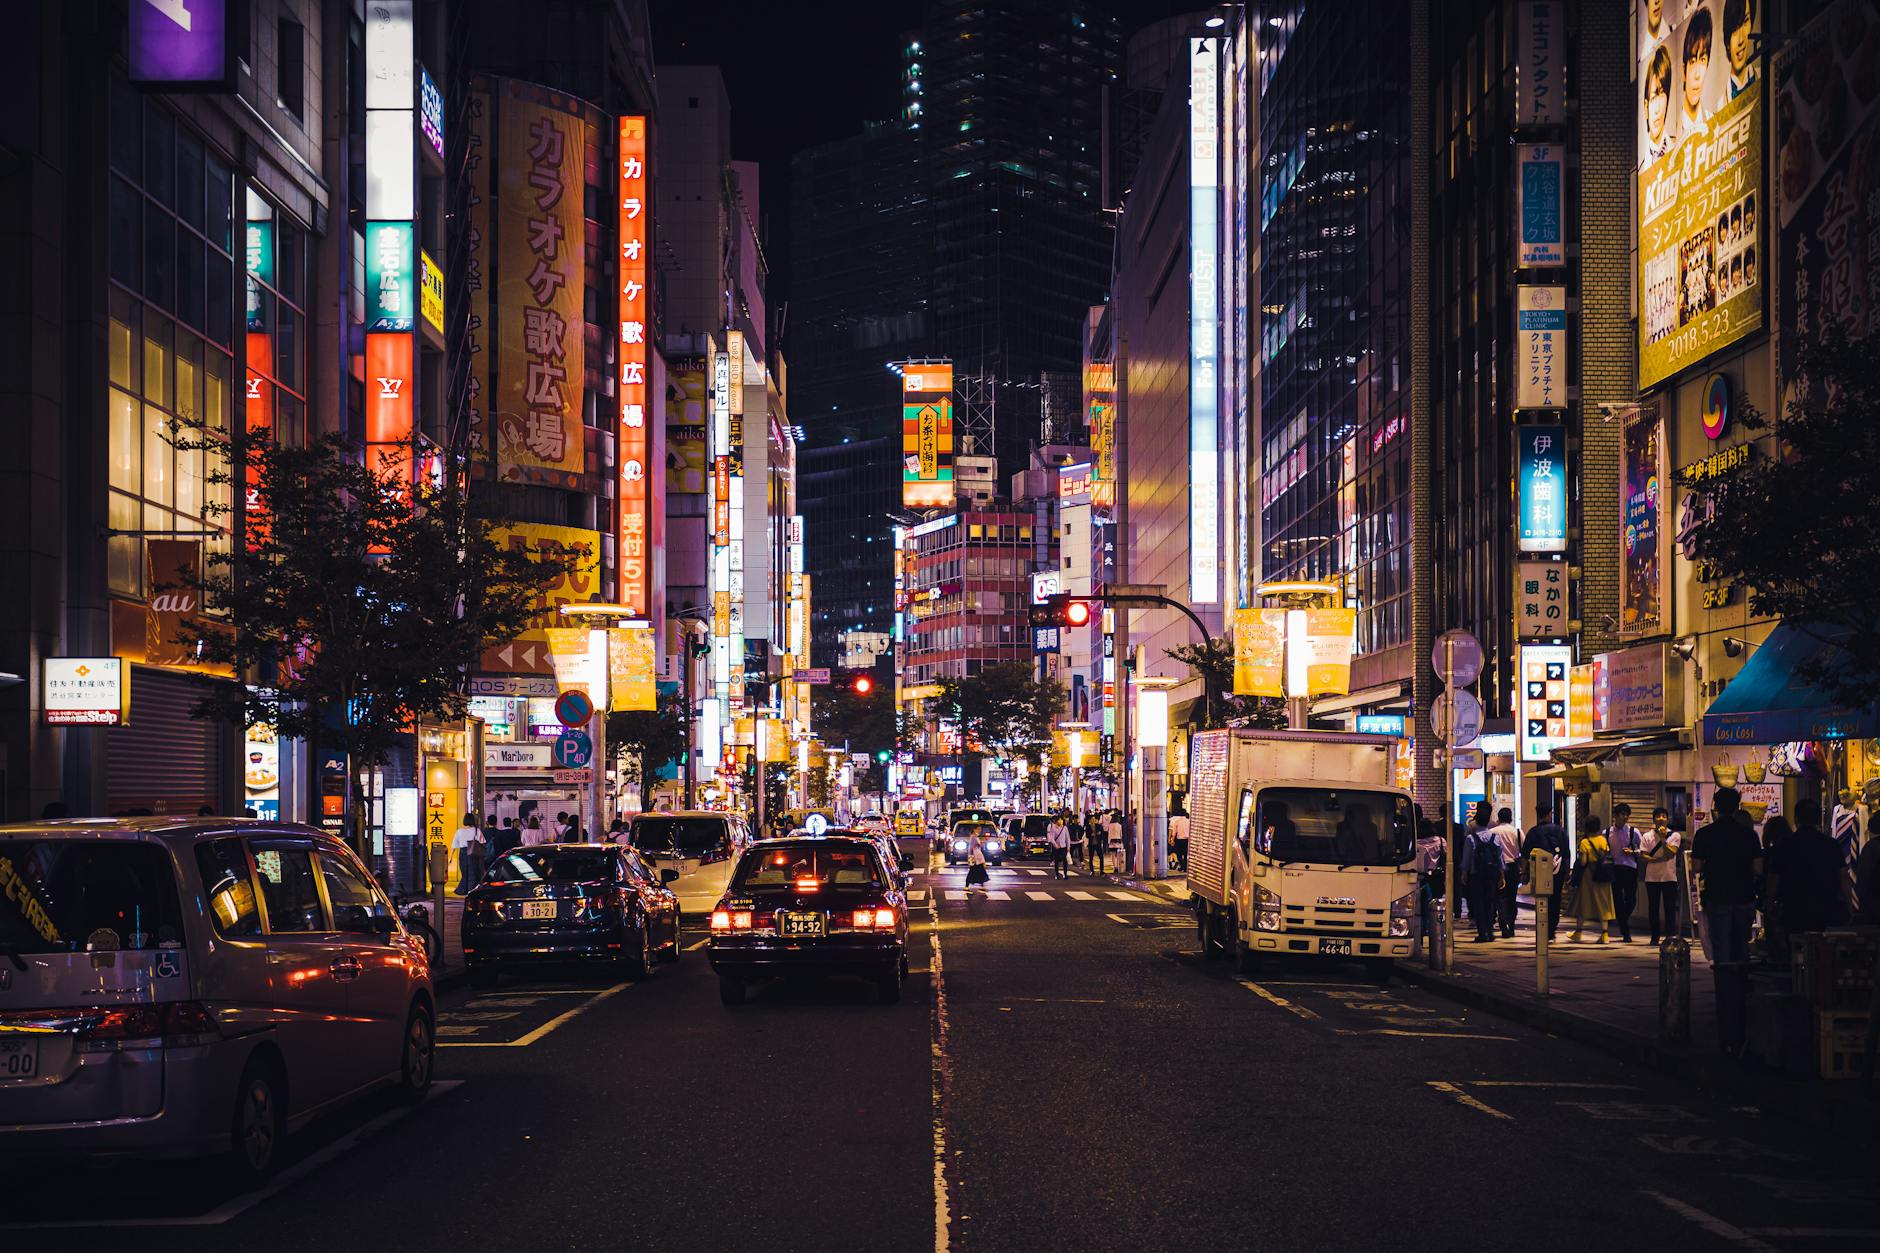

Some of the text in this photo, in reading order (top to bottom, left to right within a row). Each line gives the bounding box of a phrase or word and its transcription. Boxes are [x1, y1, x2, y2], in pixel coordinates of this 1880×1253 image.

[1533, 147, 1549, 160] 3F
[1645, 167, 1682, 214] King
[1694, 113, 1751, 178] Prince
[1525, 165, 1540, 241] クリニック
[1541, 165, 1556, 241] 渋谷道玄坂
[1653, 167, 1746, 250] シンデレラガール
[523, 117, 567, 463] カラオケ歌広場
[622, 157, 644, 429] カラオケ歌広場
[1195, 250, 1214, 388] For Your JUST
[1668, 308, 1730, 363] 2018.5.23
[676, 358, 705, 372] aiko
[1530, 332, 1540, 386] クリニック
[1542, 332, 1553, 406] 東京プラチナム
[676, 428, 705, 441] aiko
[1532, 435, 1553, 524] 伊波歯科
[622, 512, 643, 604] 受付5F
[152, 594, 195, 612] au
[1525, 580, 1540, 617] 眼科
[1546, 568, 1561, 619] なかの
[1036, 628, 1058, 650] 薬局
[50, 680, 116, 688] 住友不動産販売
[1360, 723, 1402, 733] 伊波歯科
[501, 750, 534, 762] Marlboro
[563, 740, 579, 764] P
[574, 753, 585, 764] 40
[529, 906, 555, 917] 30-21
[1316, 896, 1356, 906] ISUZU
[791, 921, 821, 934] 94-92
[1325, 944, 1351, 955] 66-40
